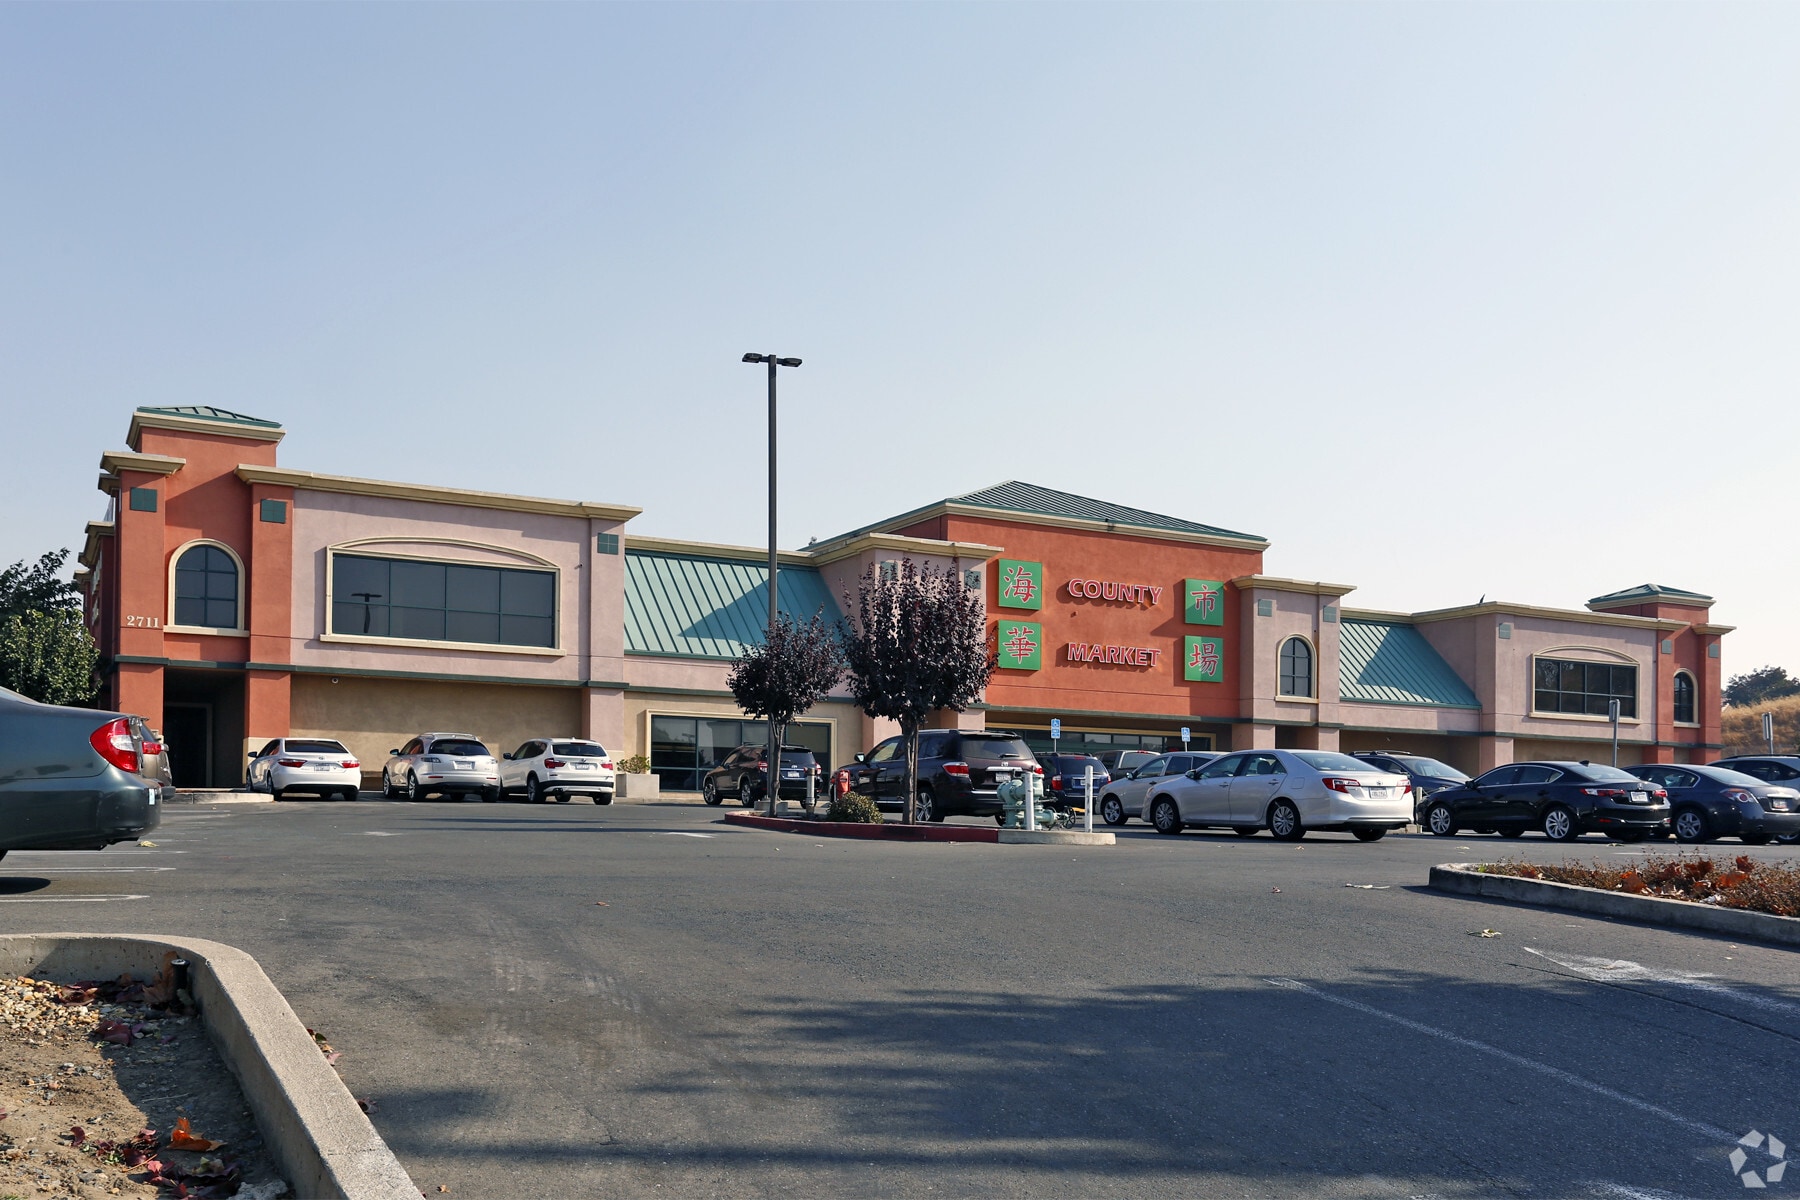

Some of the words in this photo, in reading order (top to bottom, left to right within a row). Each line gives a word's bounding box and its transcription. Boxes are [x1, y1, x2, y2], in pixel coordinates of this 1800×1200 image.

[1067, 578, 1163, 604] COUNTY
[126, 615, 159, 628] 2711
[1067, 642, 1161, 666] MARKET
